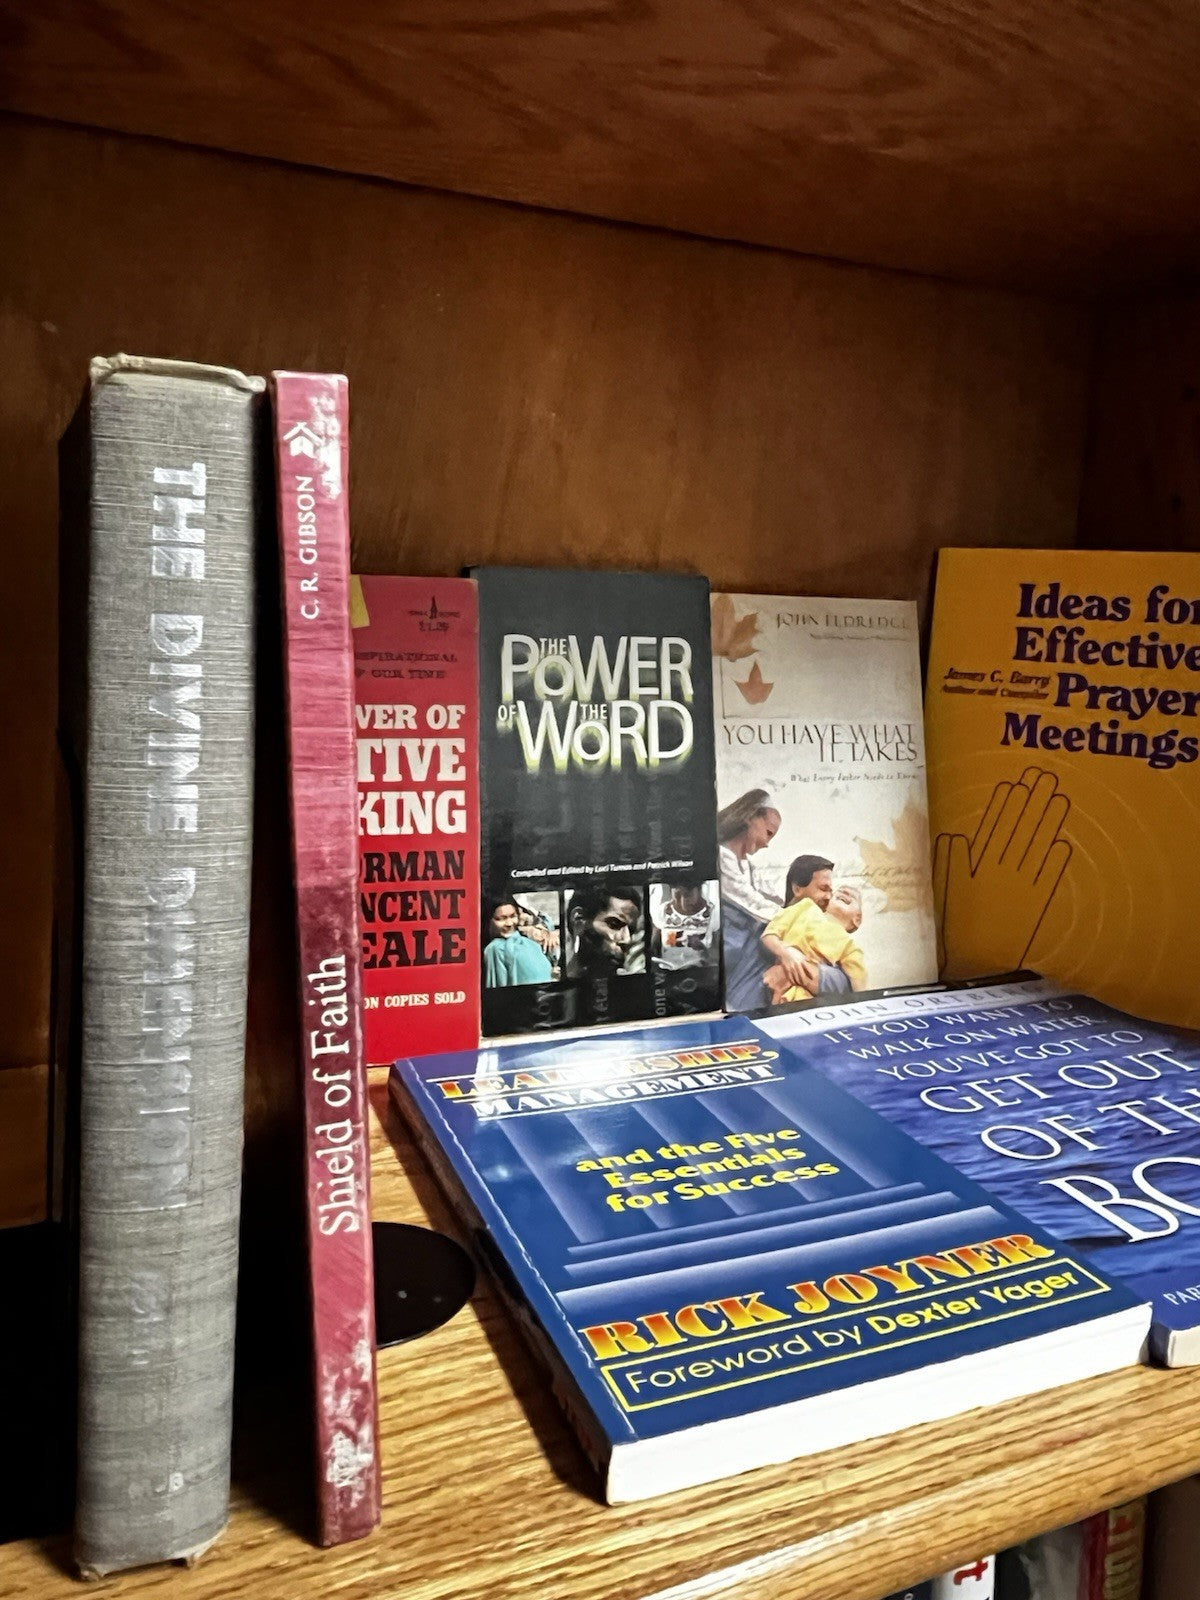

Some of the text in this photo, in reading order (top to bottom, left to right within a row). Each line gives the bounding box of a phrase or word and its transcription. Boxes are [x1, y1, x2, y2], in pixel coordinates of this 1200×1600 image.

[151, 463, 207, 580] THE
[298, 475, 320, 620] C. R. GIBSON
[777, 612, 819, 628] JOHN
[1016, 582, 1131, 622] Ideas
[501, 633, 694, 702] THE POWER
[1013, 625, 1200, 672] Effective
[426, 704, 466, 730] OF
[1053, 672, 1200, 721] Prayer
[147, 613, 204, 833] DIVINE
[497, 700, 694, 769] OF THE WORD
[723, 723, 918, 745] YOU HAVE WHAT
[1000, 711, 1199, 770] Meetings
[356, 737, 466, 783] TIVE
[845, 742, 918, 763] TAKES
[358, 790, 467, 836] KING
[360, 850, 465, 884] RMAN
[511, 867, 547, 878] Compiled
[547, 868, 561, 876] and
[562, 865, 585, 875] Edited
[585, 866, 595, 875] by
[633, 862, 646, 870] and
[384, 993, 430, 1008] COPIES
[433, 990, 466, 1005] SOLD
[797, 1000, 890, 1027] JOHN
[824, 1028, 855, 1044] IF
[859, 1016, 931, 1038] YOU
[934, 1005, 1027, 1026] WANT
[1027, 999, 1075, 1014] TO
[846, 1035, 942, 1060] WALK
[943, 1028, 998, 1047] ON
[875, 1029, 1144, 1081] YOU'VE GOT TO
[307, 954, 359, 1235] Shield of Faith
[471, 1064, 777, 1118] MANAGEMENT
[919, 1047, 1199, 1114] GET OUT
[575, 1126, 802, 1173] and the Five
[979, 1114, 1109, 1160] OF
[602, 1145, 807, 1190] Essentials
[605, 1159, 841, 1213] for Success
[579, 1232, 1056, 1362] RICK JOYNER
[1163, 1284, 1200, 1305] PAR
[625, 1271, 1080, 1393] Foreword by Dexter Yager
